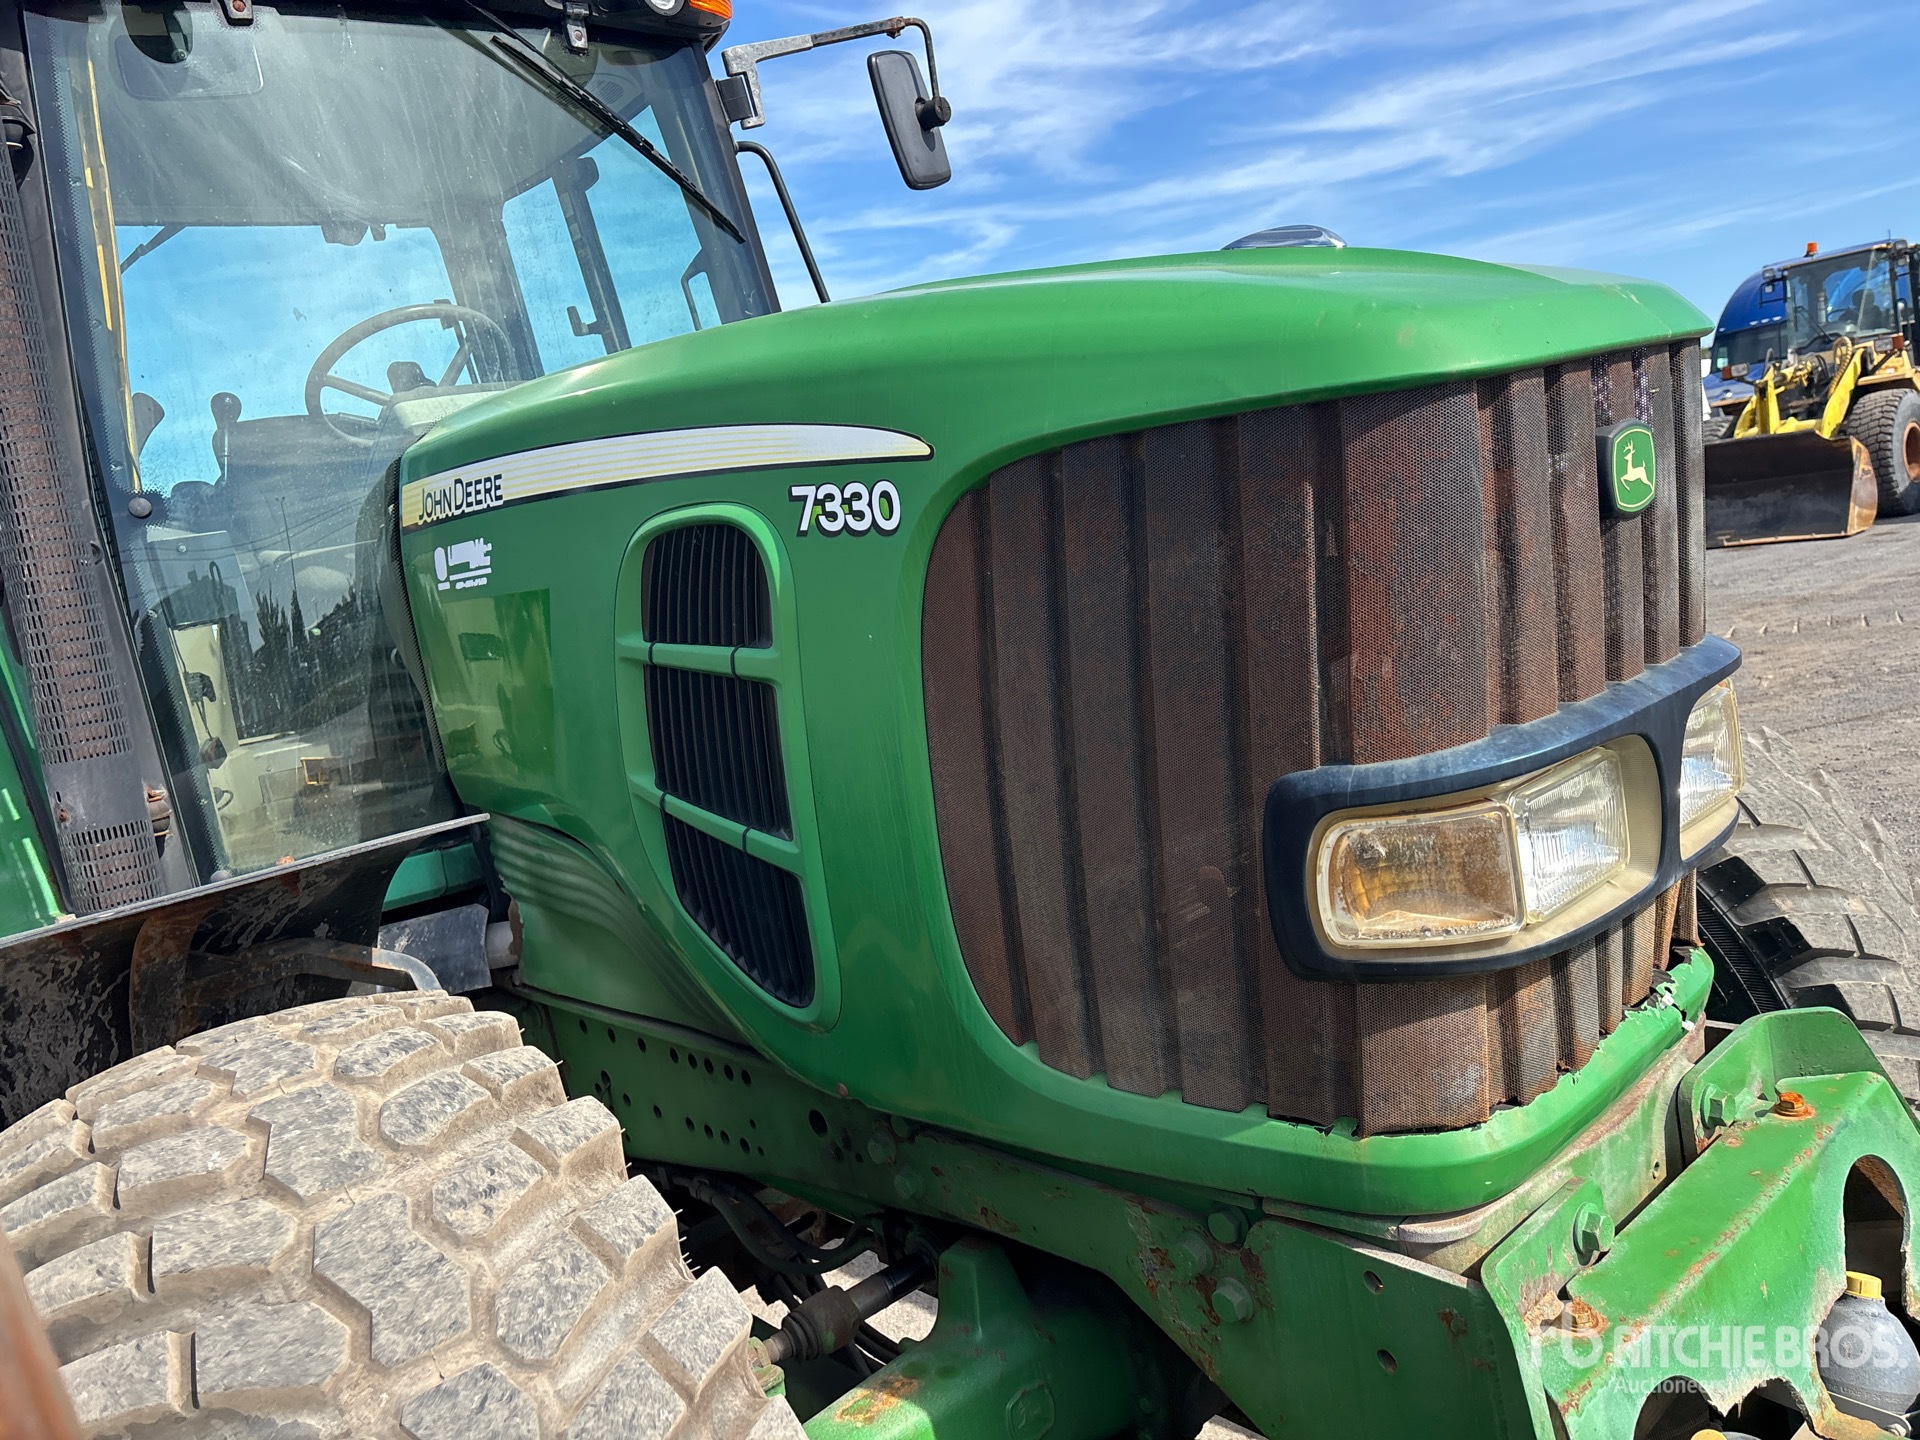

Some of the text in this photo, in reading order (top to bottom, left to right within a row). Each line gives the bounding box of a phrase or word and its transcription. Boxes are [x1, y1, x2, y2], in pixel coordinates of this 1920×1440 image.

[418, 473, 504, 521] JOHN DEERE
[788, 479, 902, 538] 7330
